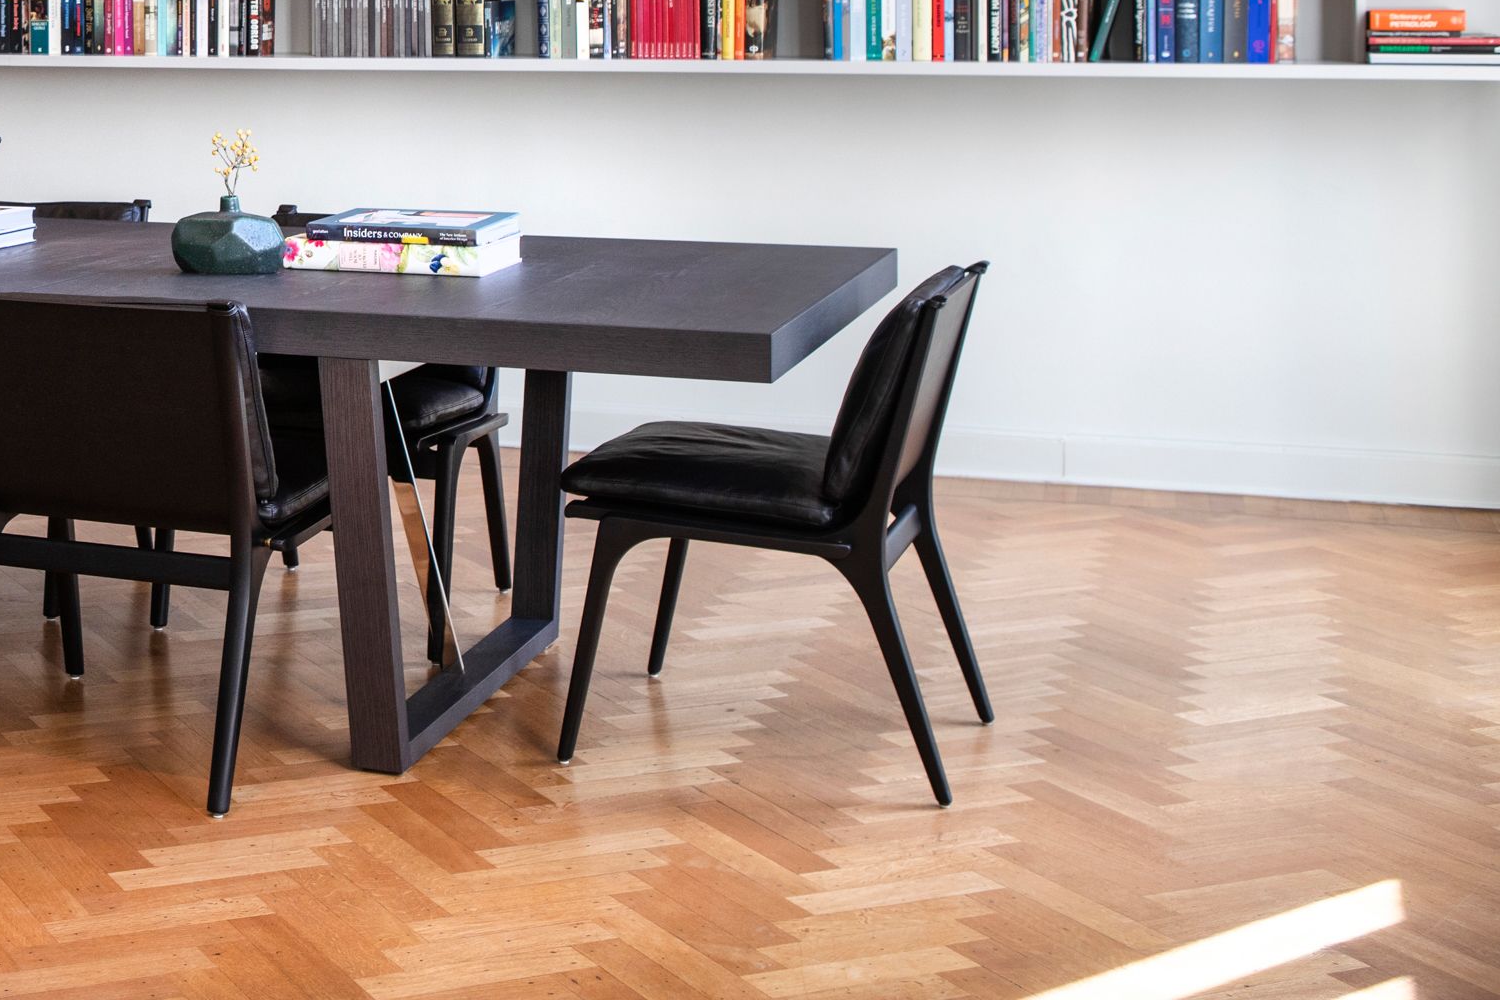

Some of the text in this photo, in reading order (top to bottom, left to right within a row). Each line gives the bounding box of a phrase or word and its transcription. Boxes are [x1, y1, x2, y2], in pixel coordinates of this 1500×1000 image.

[707, 15, 715, 28] LES
[250, 18, 259, 50] OORLOG
[343, 228, 383, 239] Insiders
[388, 231, 423, 239] COMPANY
